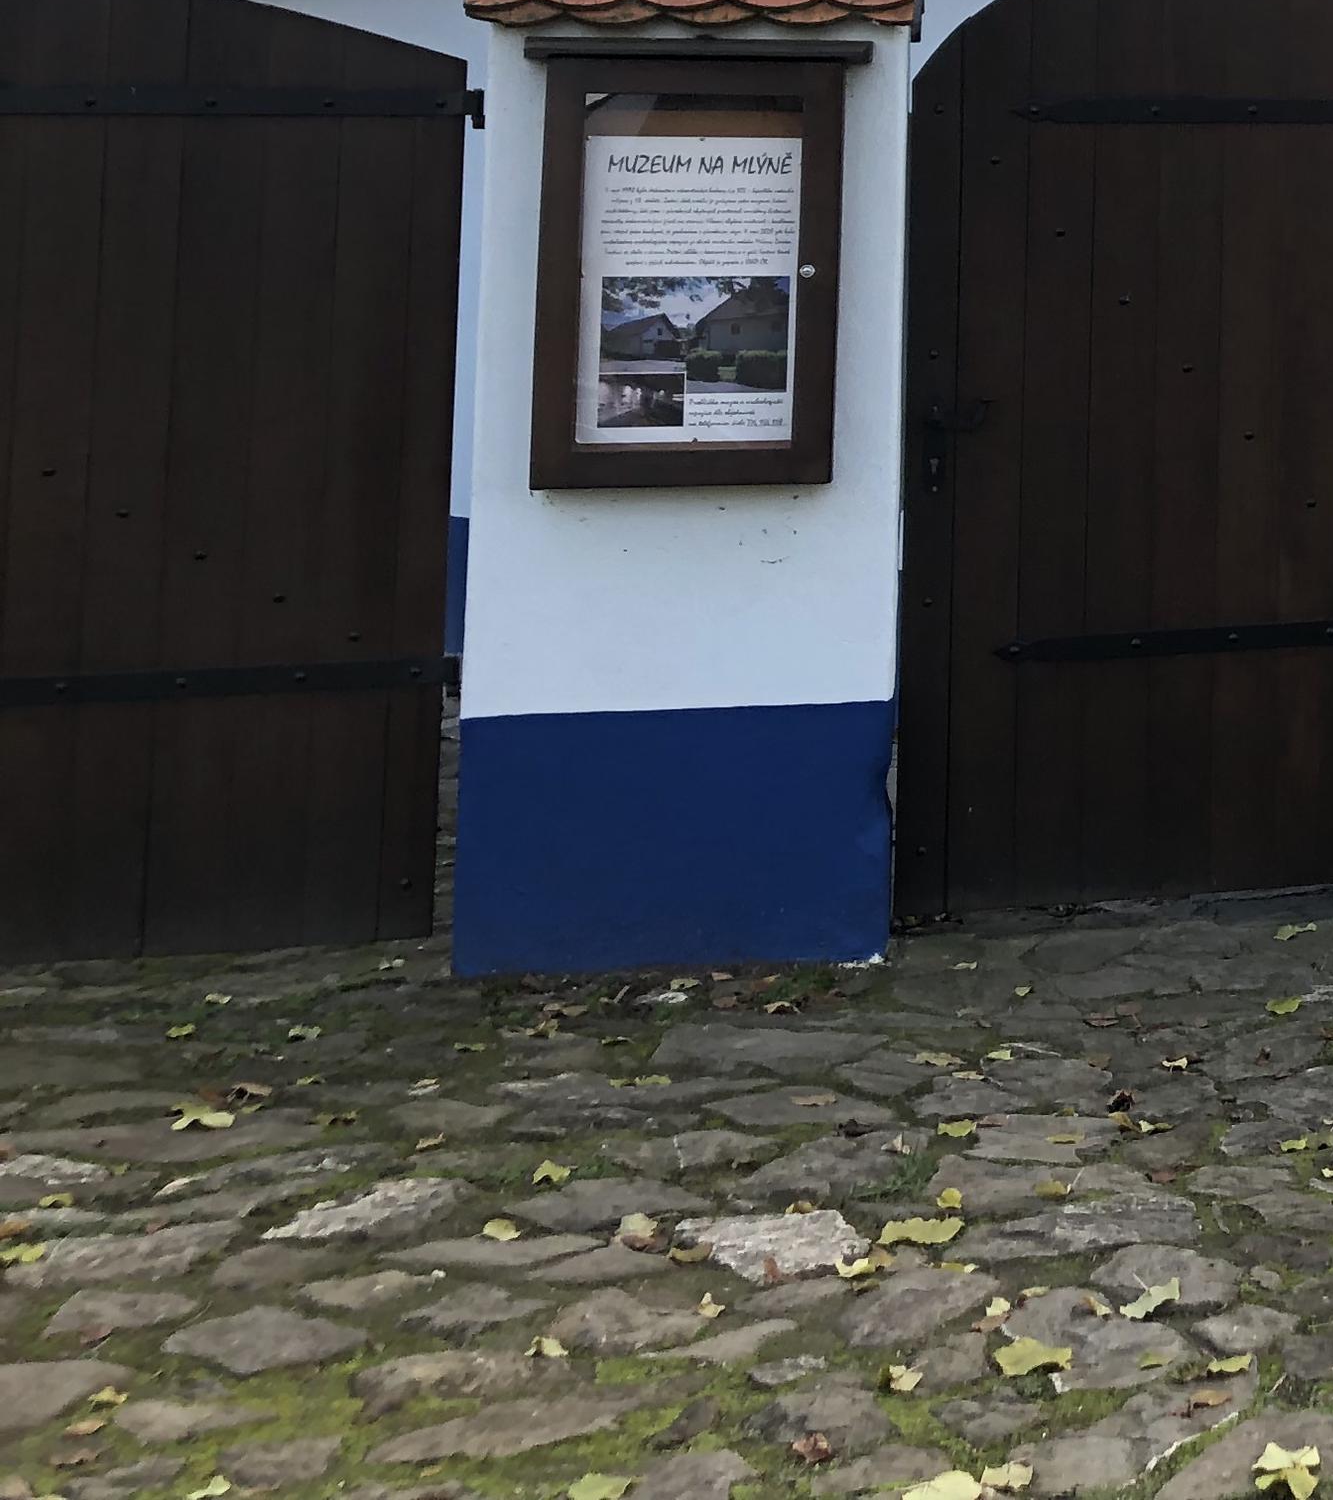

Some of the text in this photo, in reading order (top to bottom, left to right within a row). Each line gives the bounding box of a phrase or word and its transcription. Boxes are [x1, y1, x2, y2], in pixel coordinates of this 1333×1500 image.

[608, 152, 792, 175] MUZEUM NA MLÝNĚ
